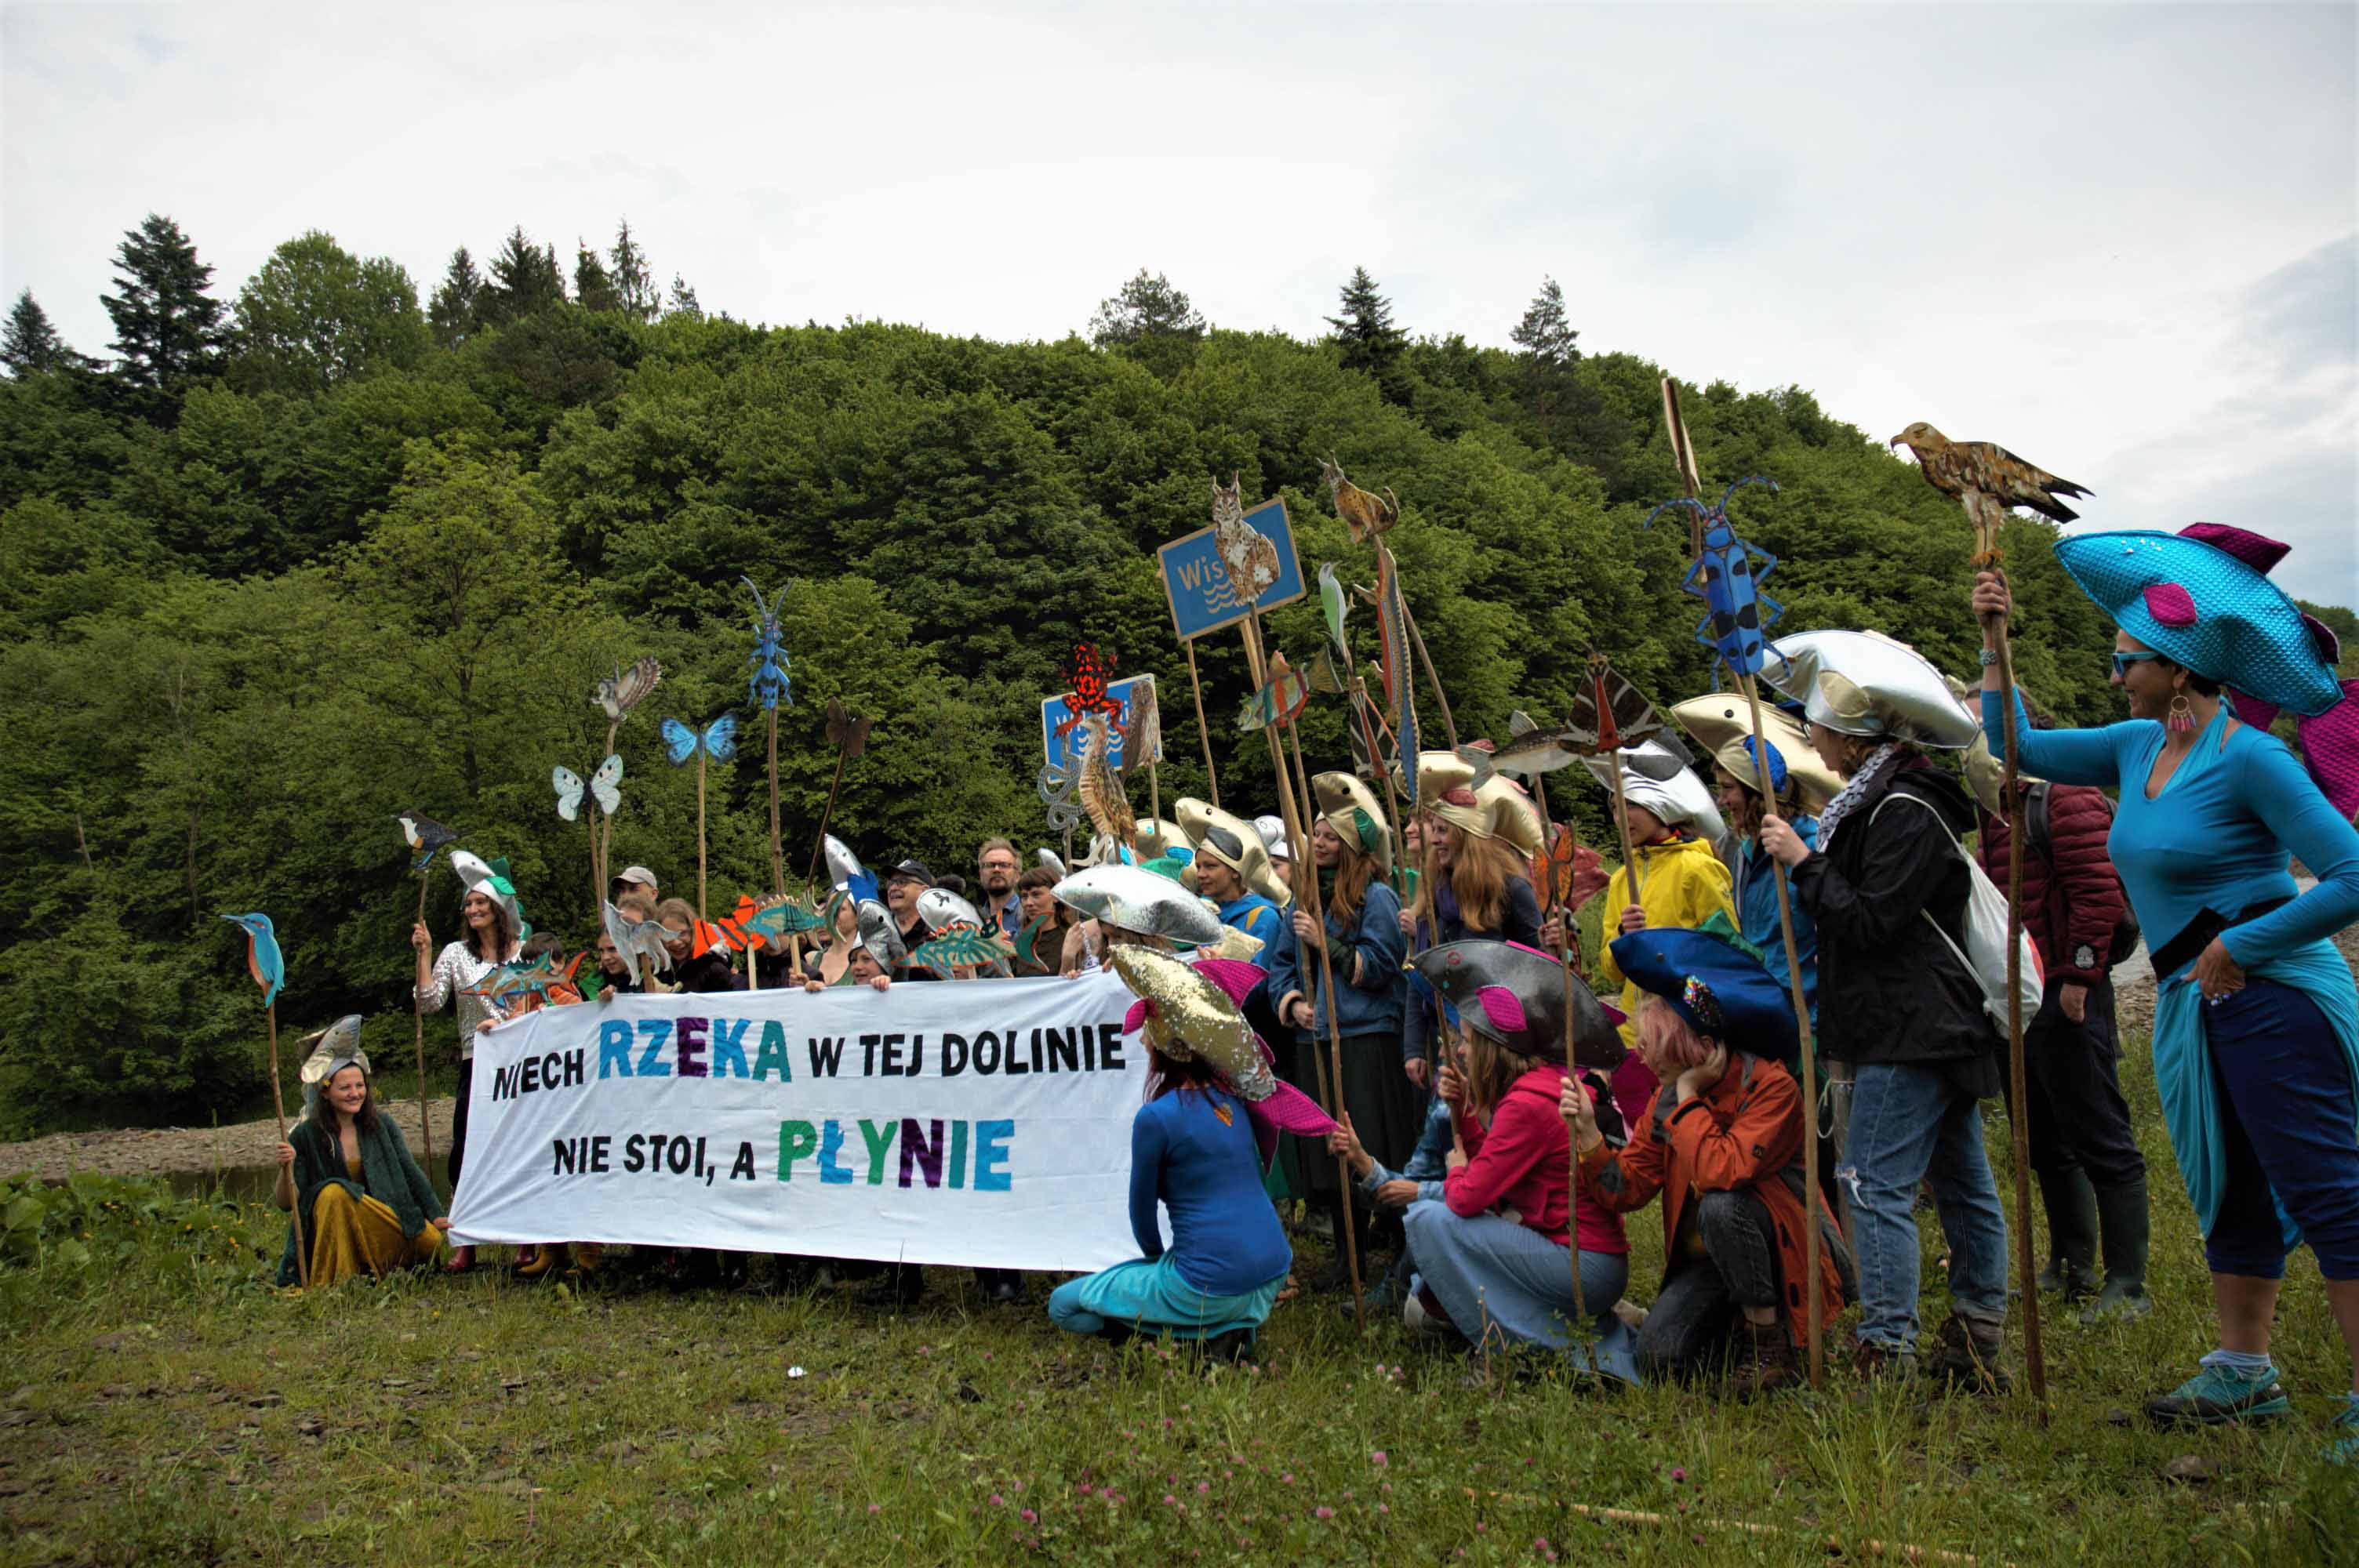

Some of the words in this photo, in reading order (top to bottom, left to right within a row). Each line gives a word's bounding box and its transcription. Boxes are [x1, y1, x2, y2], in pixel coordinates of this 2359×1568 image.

[493, 1049, 583, 1101] NIECH
[599, 1018, 791, 1082] RZEKA
[809, 1038, 845, 1077] W
[860, 1034, 922, 1076] TEJ
[942, 1024, 1125, 1076] DOLINIE
[554, 1137, 611, 1174] NIE
[624, 1134, 714, 1185] STOI,
[730, 1142, 755, 1180] A
[778, 1119, 1014, 1192] PŁYNIE
